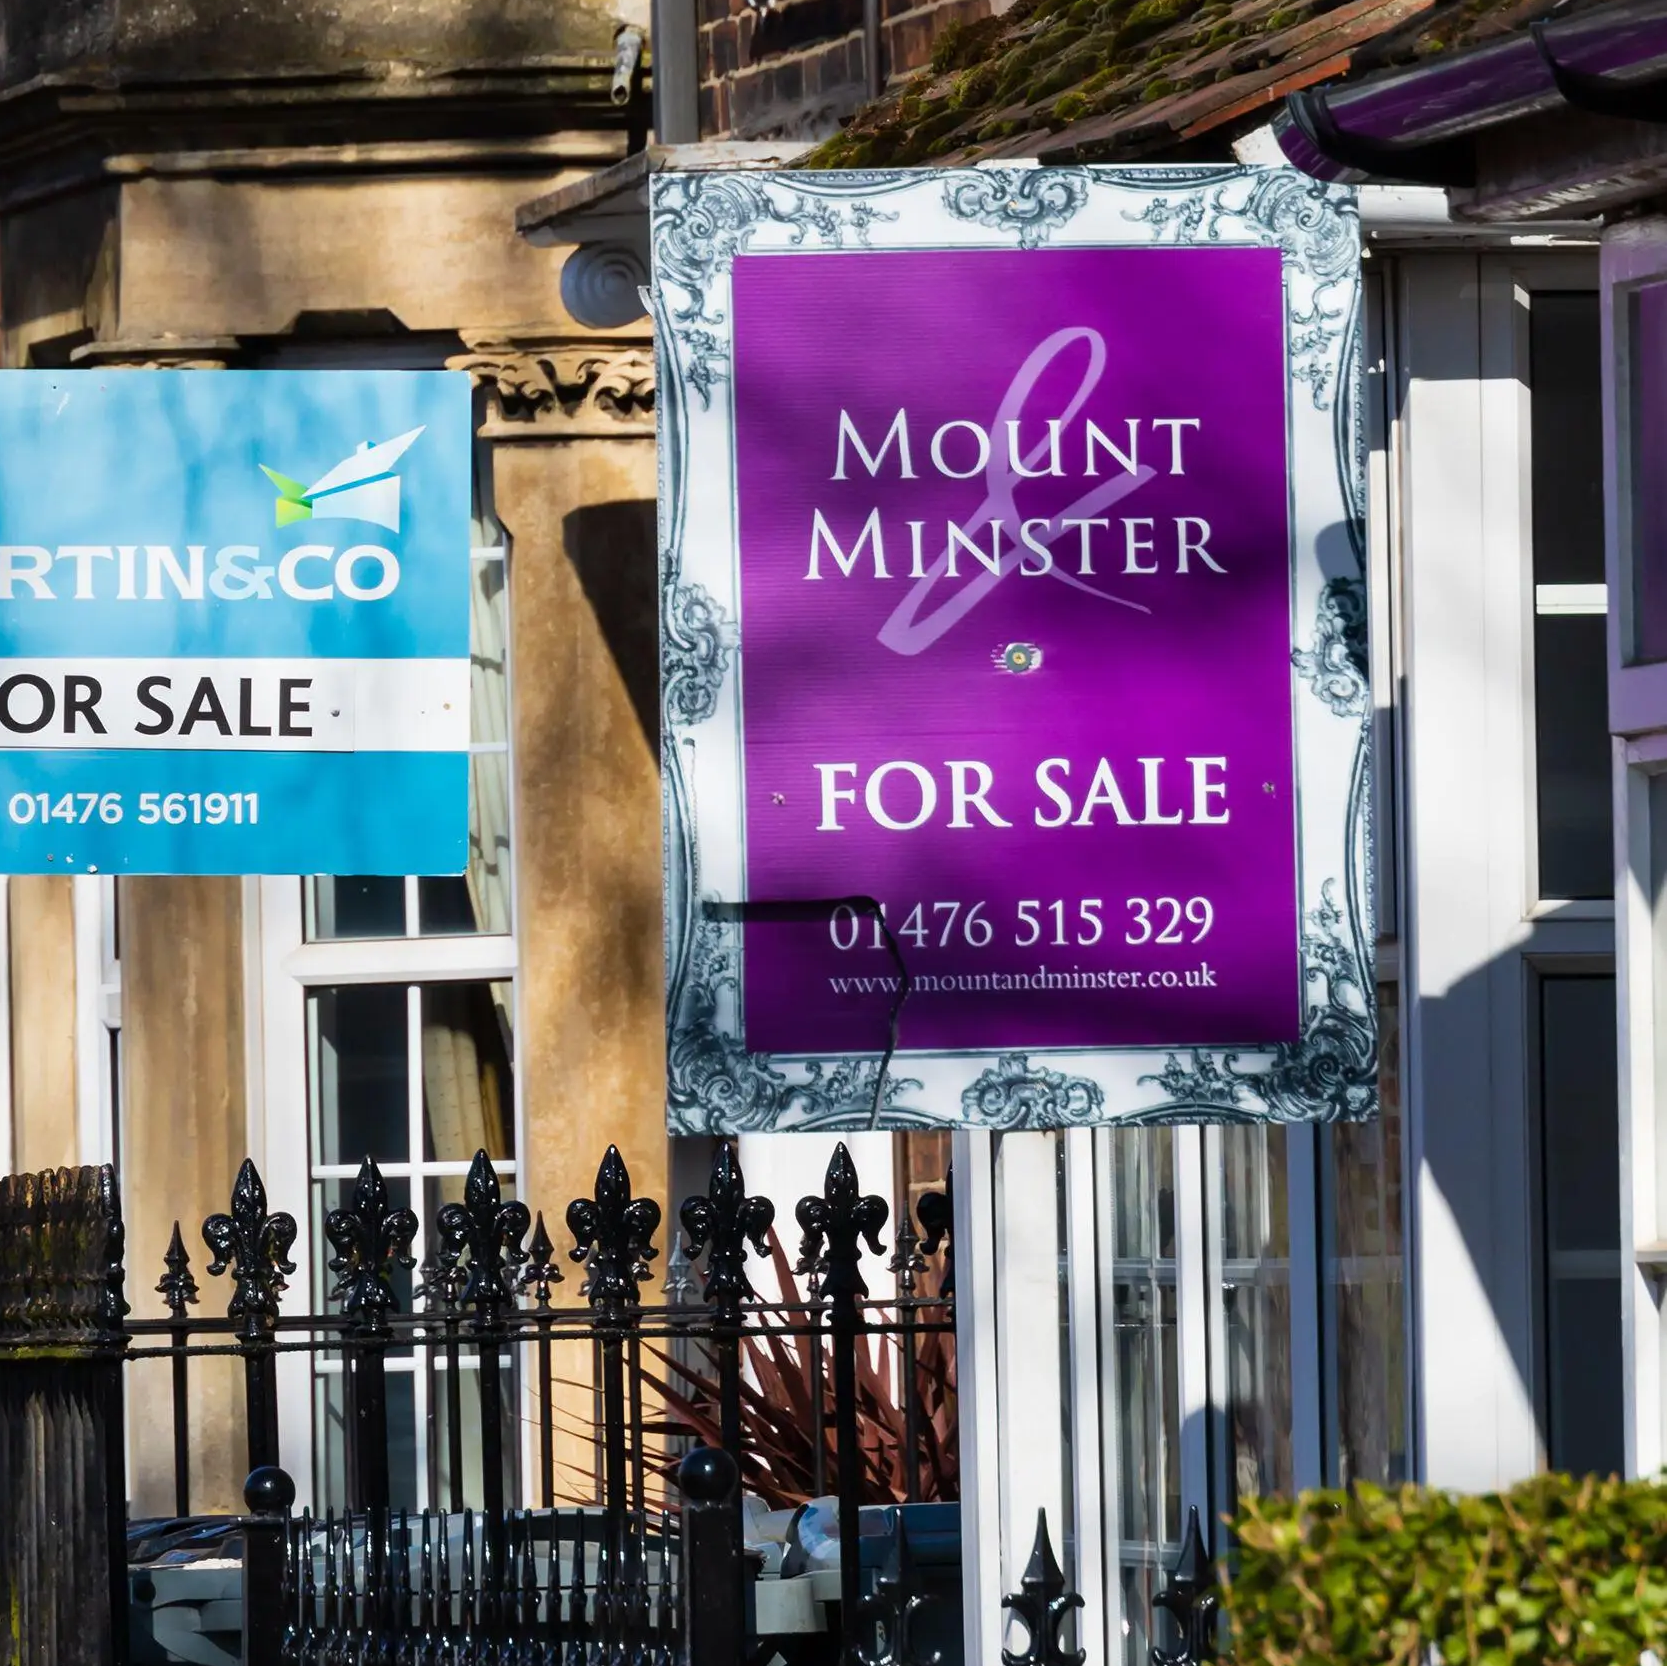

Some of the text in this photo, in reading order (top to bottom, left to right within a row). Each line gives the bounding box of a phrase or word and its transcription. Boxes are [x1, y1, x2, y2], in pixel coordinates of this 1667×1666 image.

[134, 676, 313, 737] SALE
[8, 793, 258, 824] 01476 561911
[812, 756, 1230, 832] FOR SALE
[829, 896, 1214, 950] 01476 515 329
[829, 962, 1217, 994] www.mountandminster.co.uk
